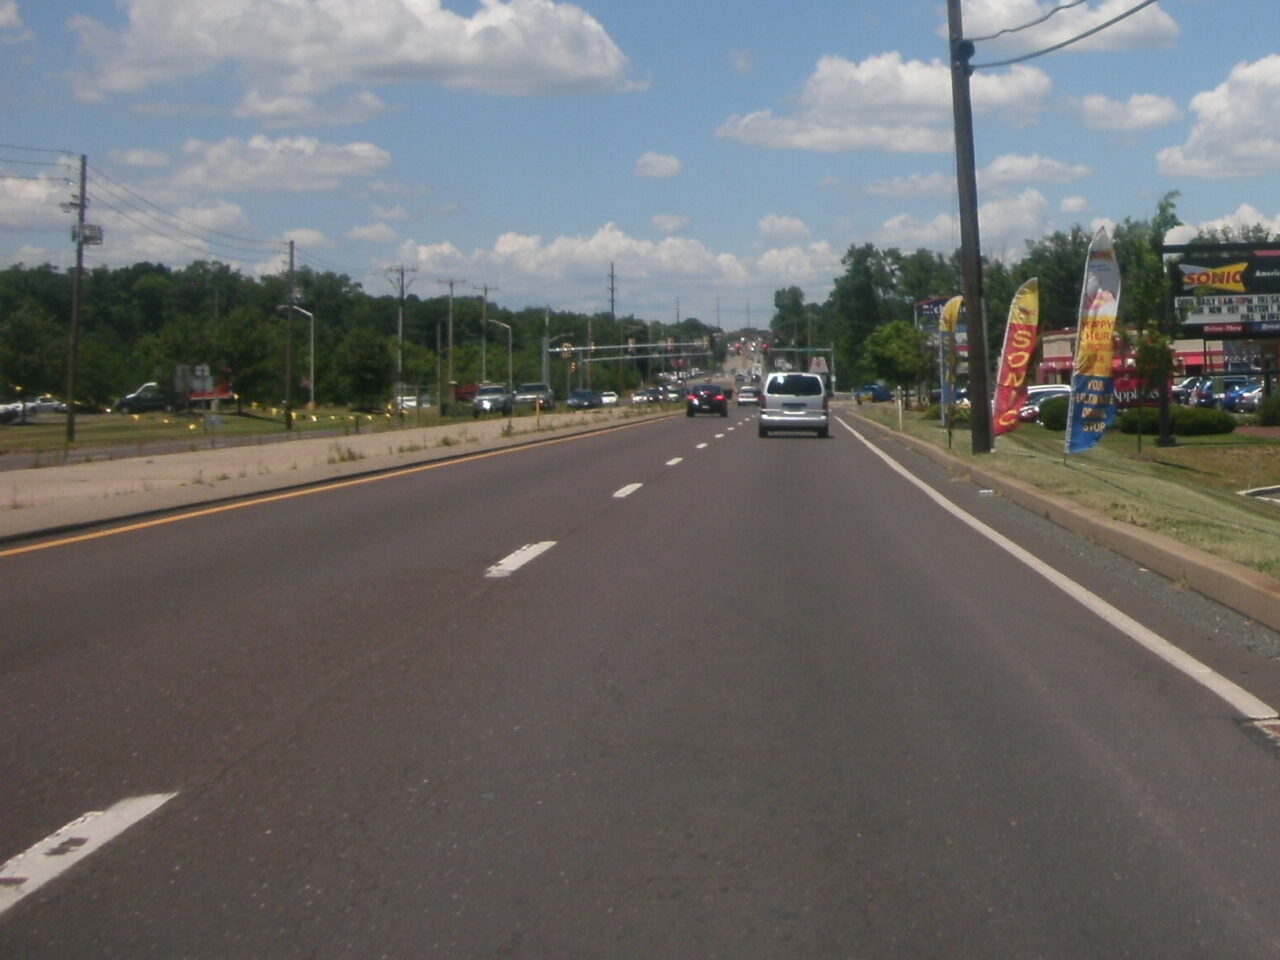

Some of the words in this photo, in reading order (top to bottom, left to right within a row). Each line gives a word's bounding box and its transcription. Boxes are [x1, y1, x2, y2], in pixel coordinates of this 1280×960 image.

[1183, 270, 1245, 284] SONIC
[999, 329, 1032, 426] SONIC
[1082, 421, 1106, 432] STOP
